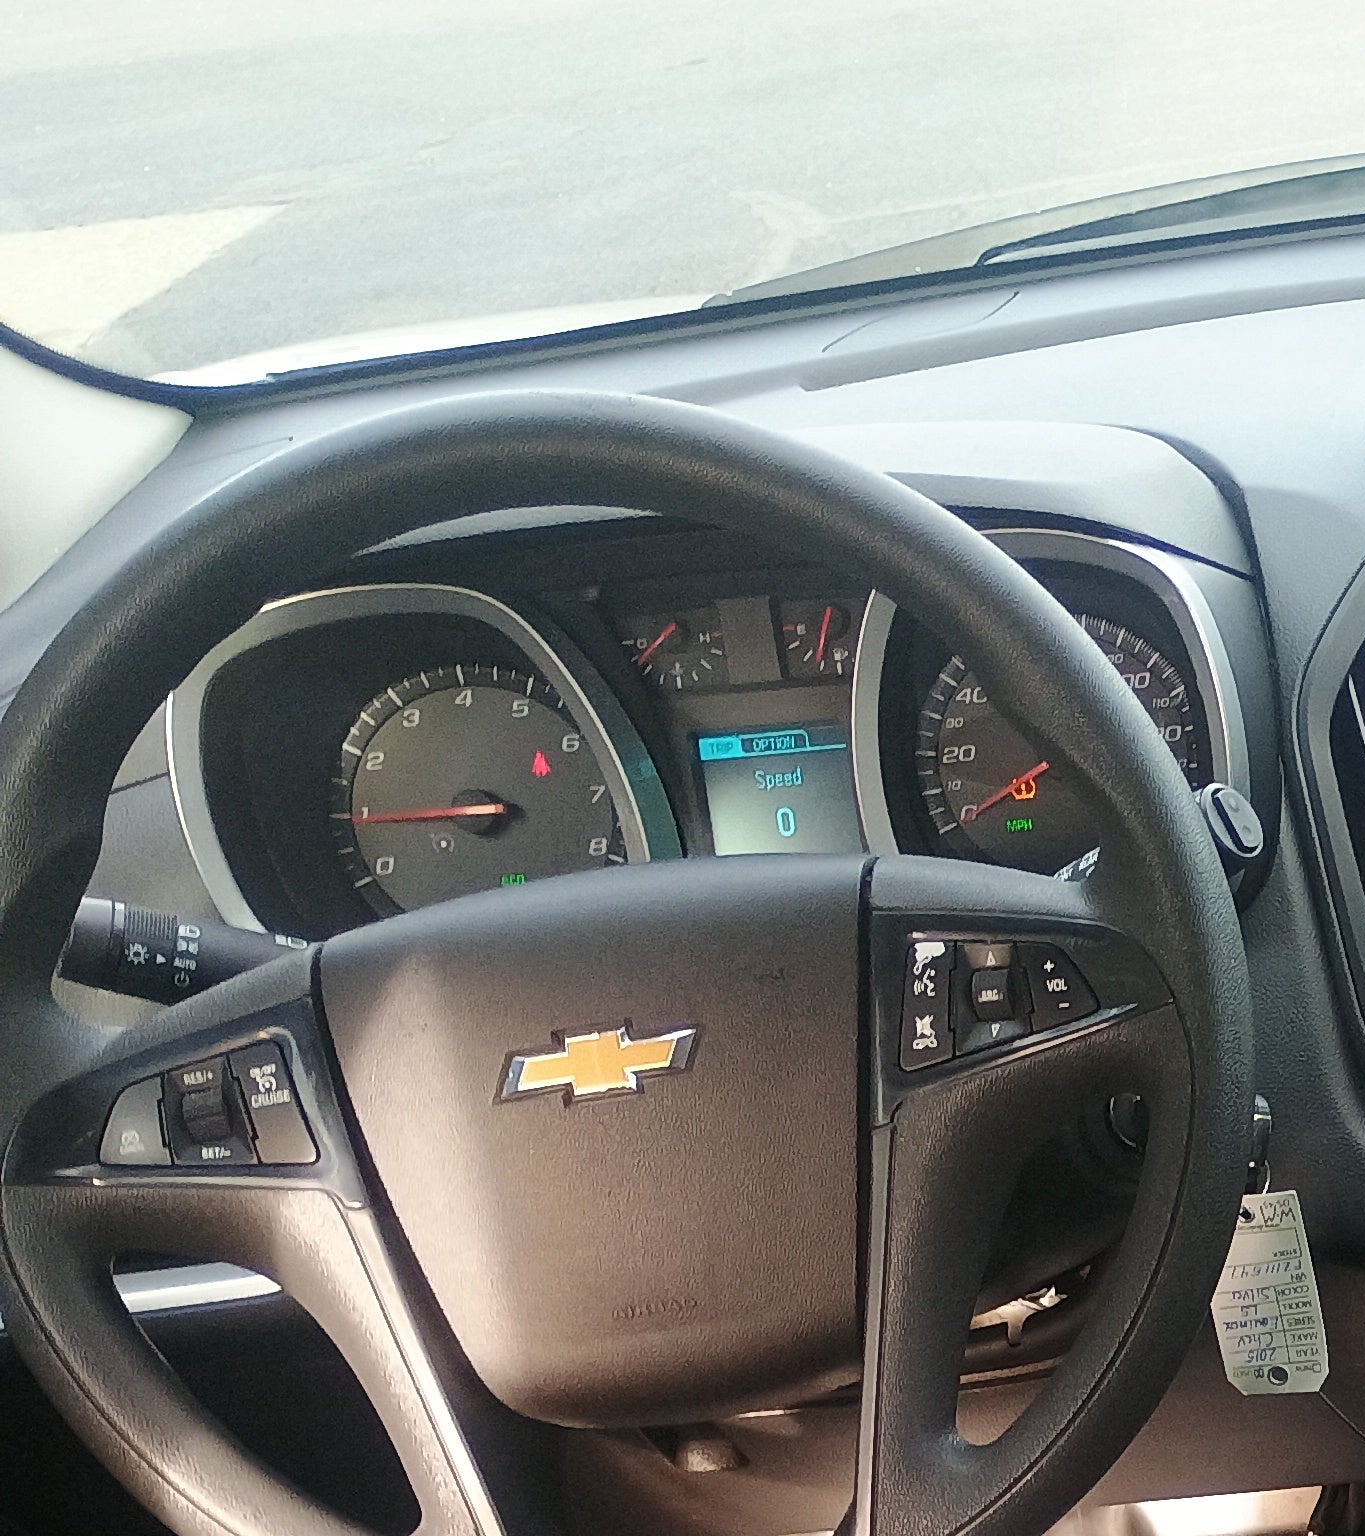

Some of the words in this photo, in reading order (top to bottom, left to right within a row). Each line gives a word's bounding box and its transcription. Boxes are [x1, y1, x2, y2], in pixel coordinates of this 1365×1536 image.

[455, 690, 473, 707] 4
[511, 700, 529, 717] 5
[402, 709, 420, 727] 3
[561, 734, 579, 752] 6
[365, 752, 385, 771] 2
[943, 745, 976, 764] 20
[754, 766, 802, 791] Speed
[588, 785, 606, 803] 7
[776, 807, 796, 837] 0
[1006, 818, 1034, 832] MPH
[588, 837, 608, 855] 8
[375, 856, 394, 875] 0
[1047, 978, 1068, 992] VOL
[1247, 1347, 1277, 1363] 2015
